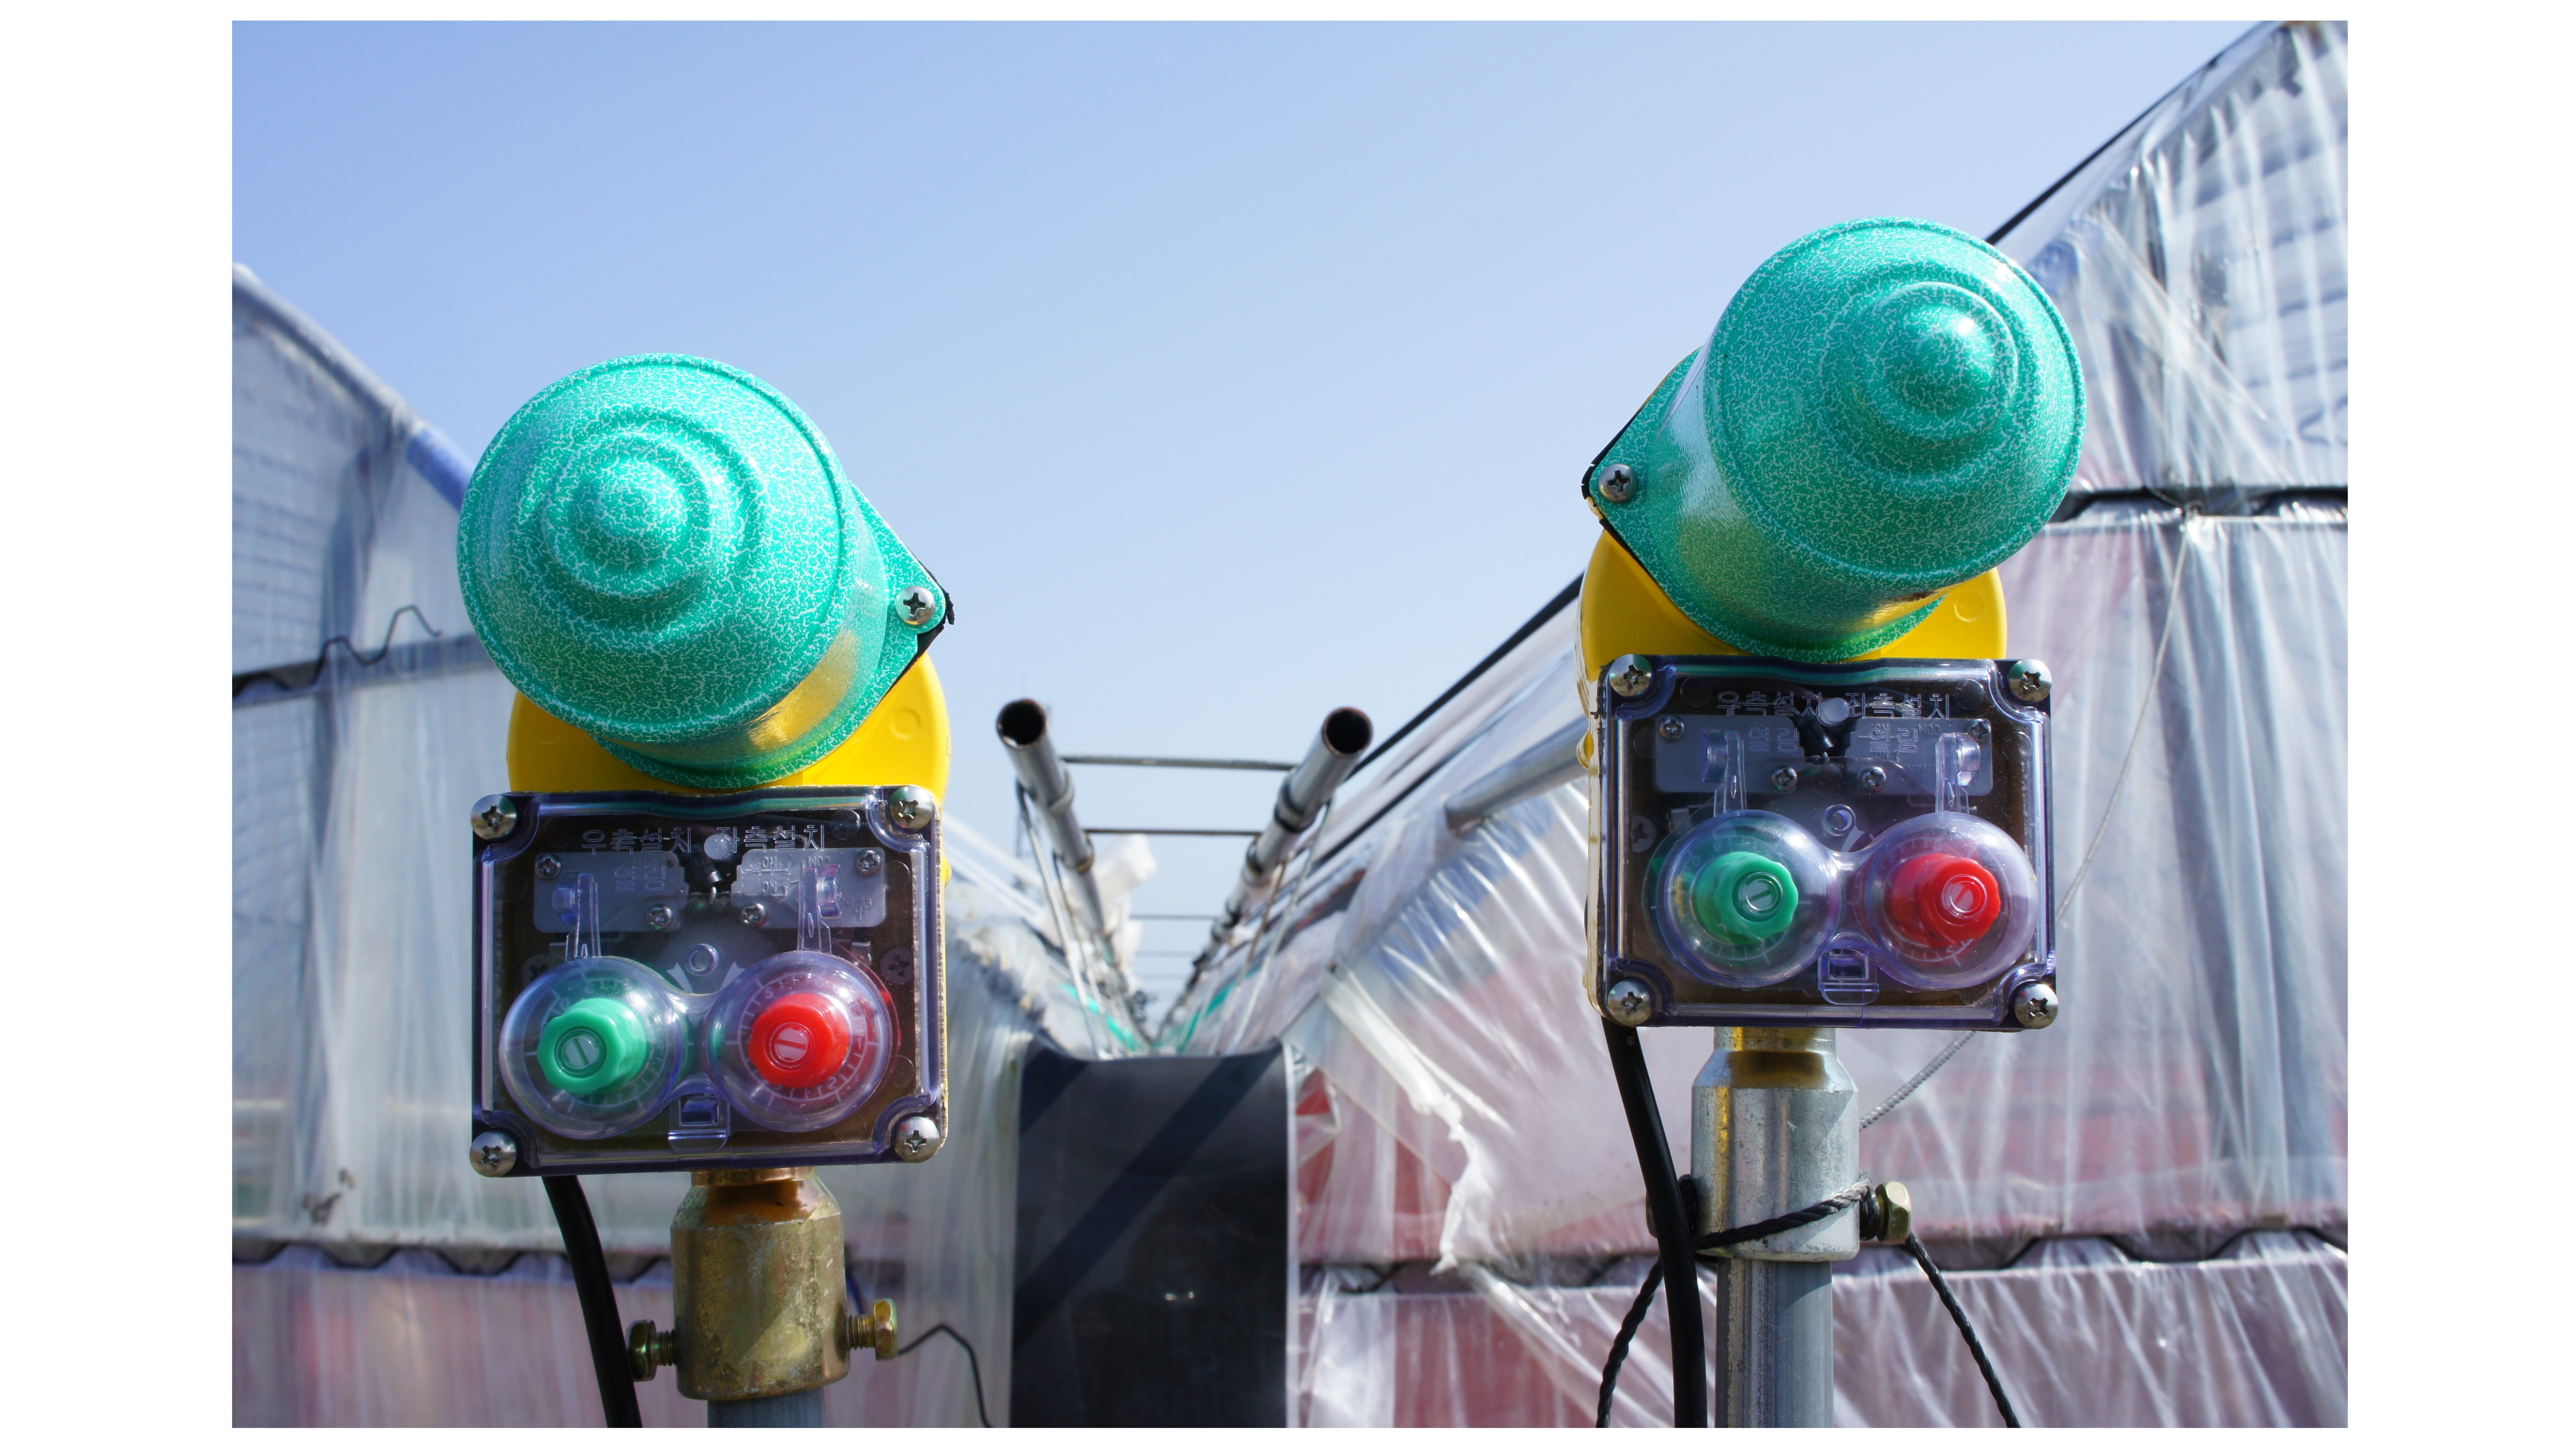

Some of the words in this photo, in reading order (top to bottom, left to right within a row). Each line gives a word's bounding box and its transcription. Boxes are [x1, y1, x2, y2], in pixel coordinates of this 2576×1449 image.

[1717, 691, 1822, 717] 우측설치
[1845, 692, 1949, 720] 좌측설치
[1748, 727, 1798, 753] 열림
[1869, 727, 1918, 753] 열림
[582, 827, 692, 855] 우측설치
[614, 865, 666, 891] 열림
